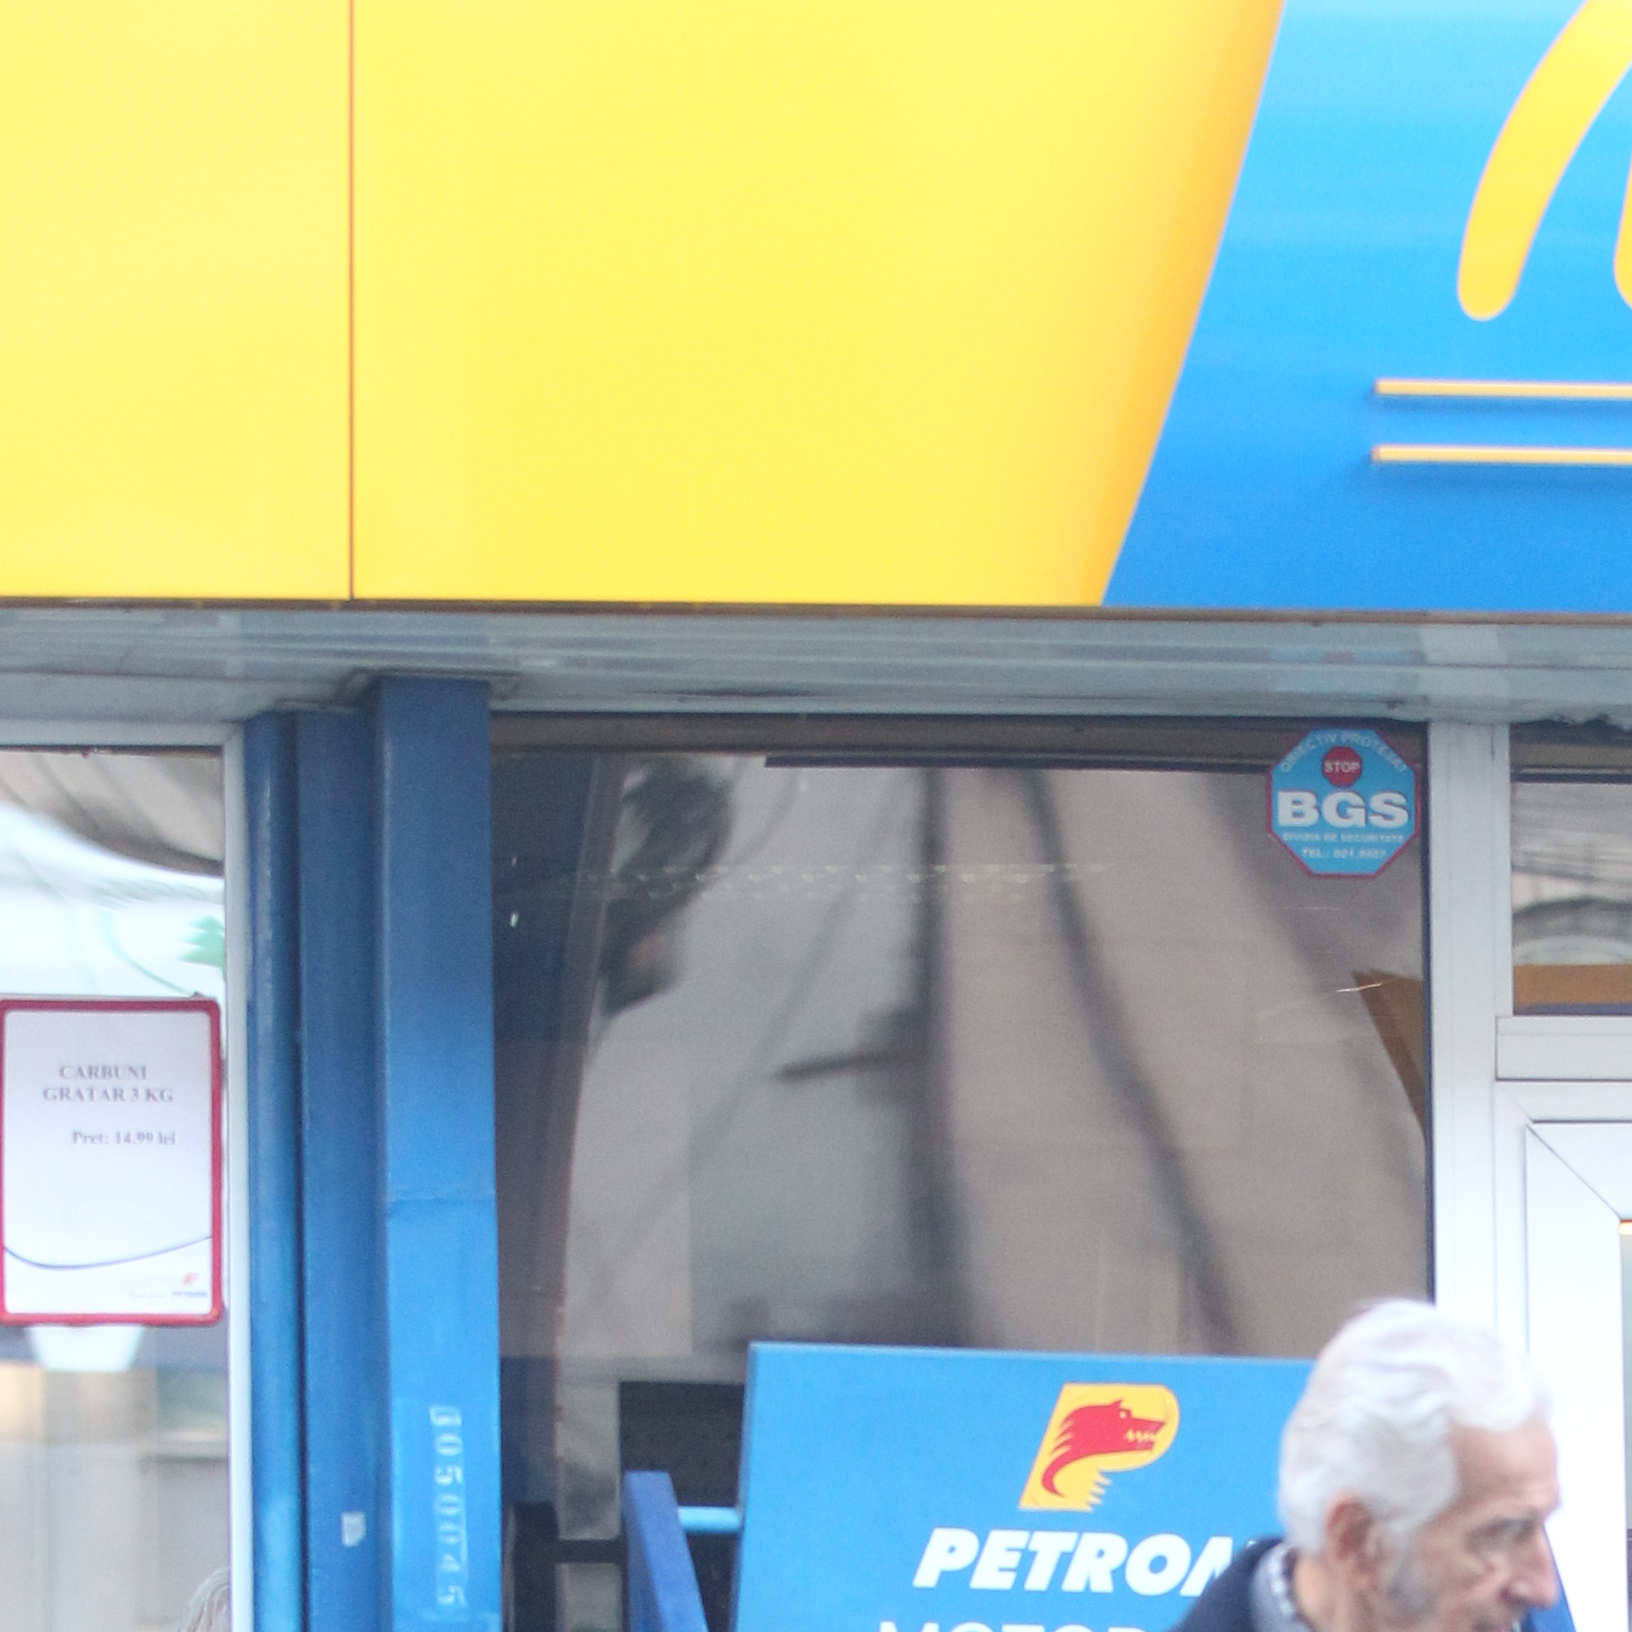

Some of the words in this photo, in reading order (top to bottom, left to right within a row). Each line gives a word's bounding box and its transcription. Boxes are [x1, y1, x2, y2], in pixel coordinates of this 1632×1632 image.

[1324, 761, 1361, 773] STOP
[1277, 790, 1411, 829] BGS
[59, 1064, 148, 1080] CARBUNI
[42, 1086, 126, 1103] GRATAR
[130, 1086, 140, 1103] 3
[145, 1086, 174, 1103] KG
